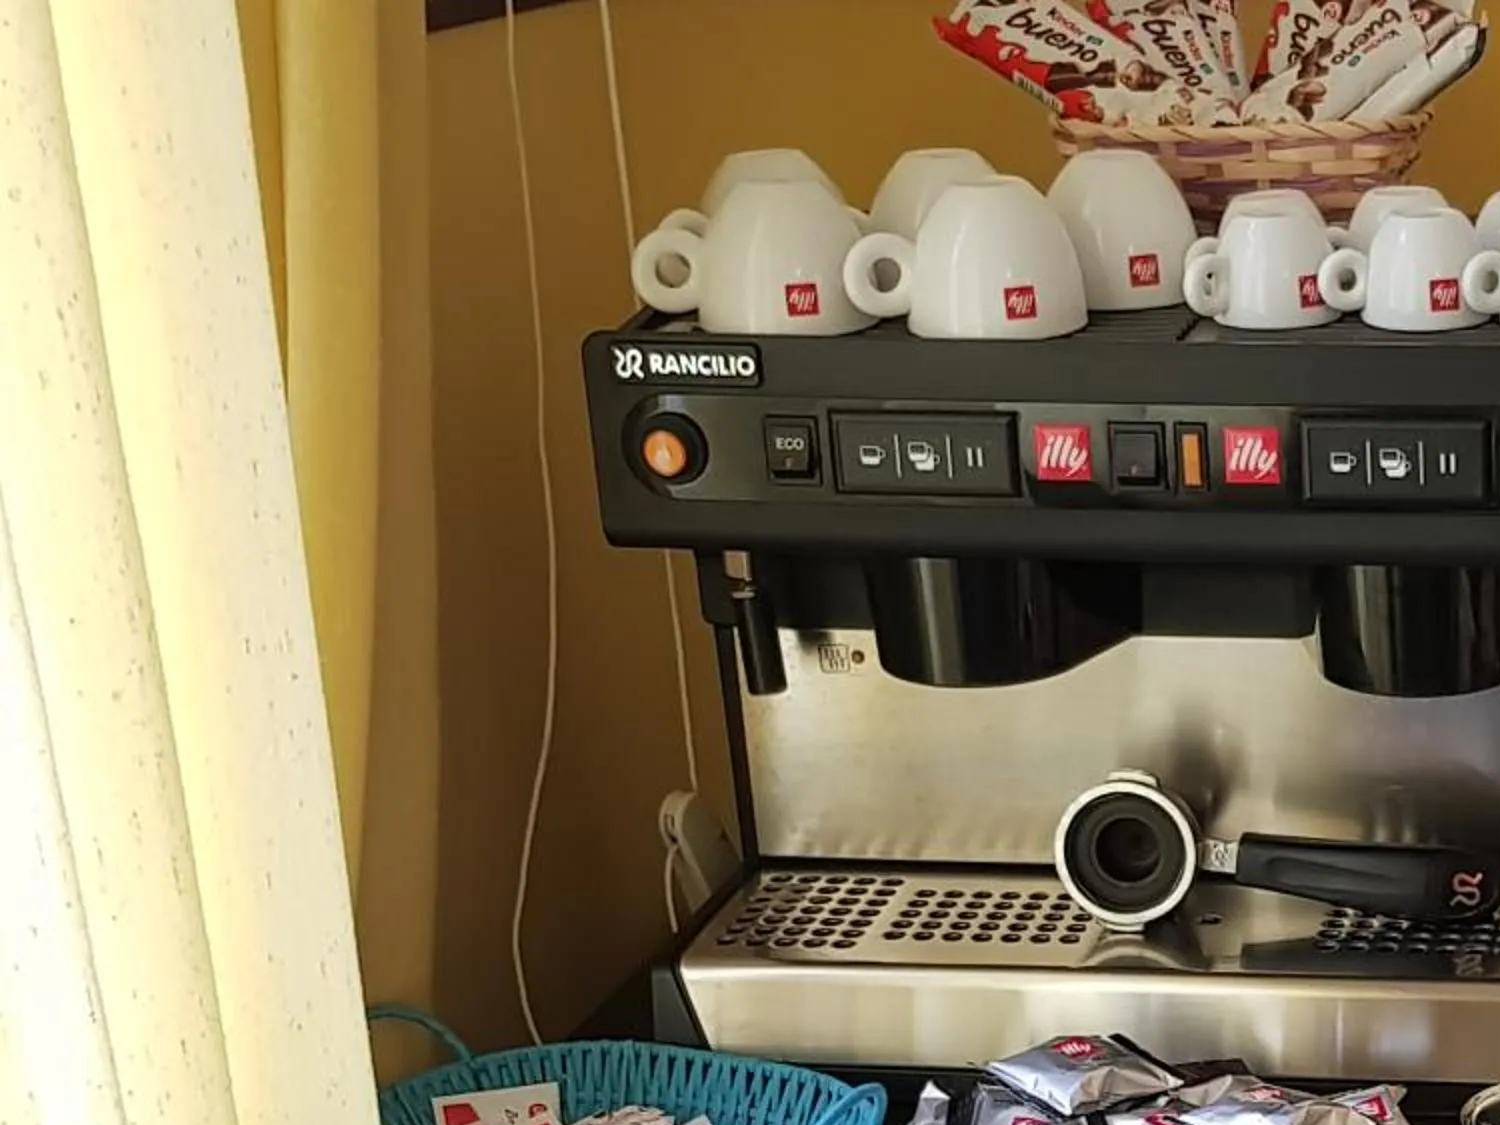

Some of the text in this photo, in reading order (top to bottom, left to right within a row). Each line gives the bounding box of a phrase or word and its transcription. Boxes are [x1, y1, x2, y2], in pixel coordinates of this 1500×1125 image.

[1005, 7, 1099, 62] bueno
[1142, 19, 1203, 86] bueno
[1287, 13, 1321, 66] bue
[1331, 8, 1402, 65] bueno
[647, 352, 756, 377] RANCILIO
[775, 437, 805, 451] ECO
[1041, 435, 1087, 477] illy
[1229, 437, 1278, 480] illy
